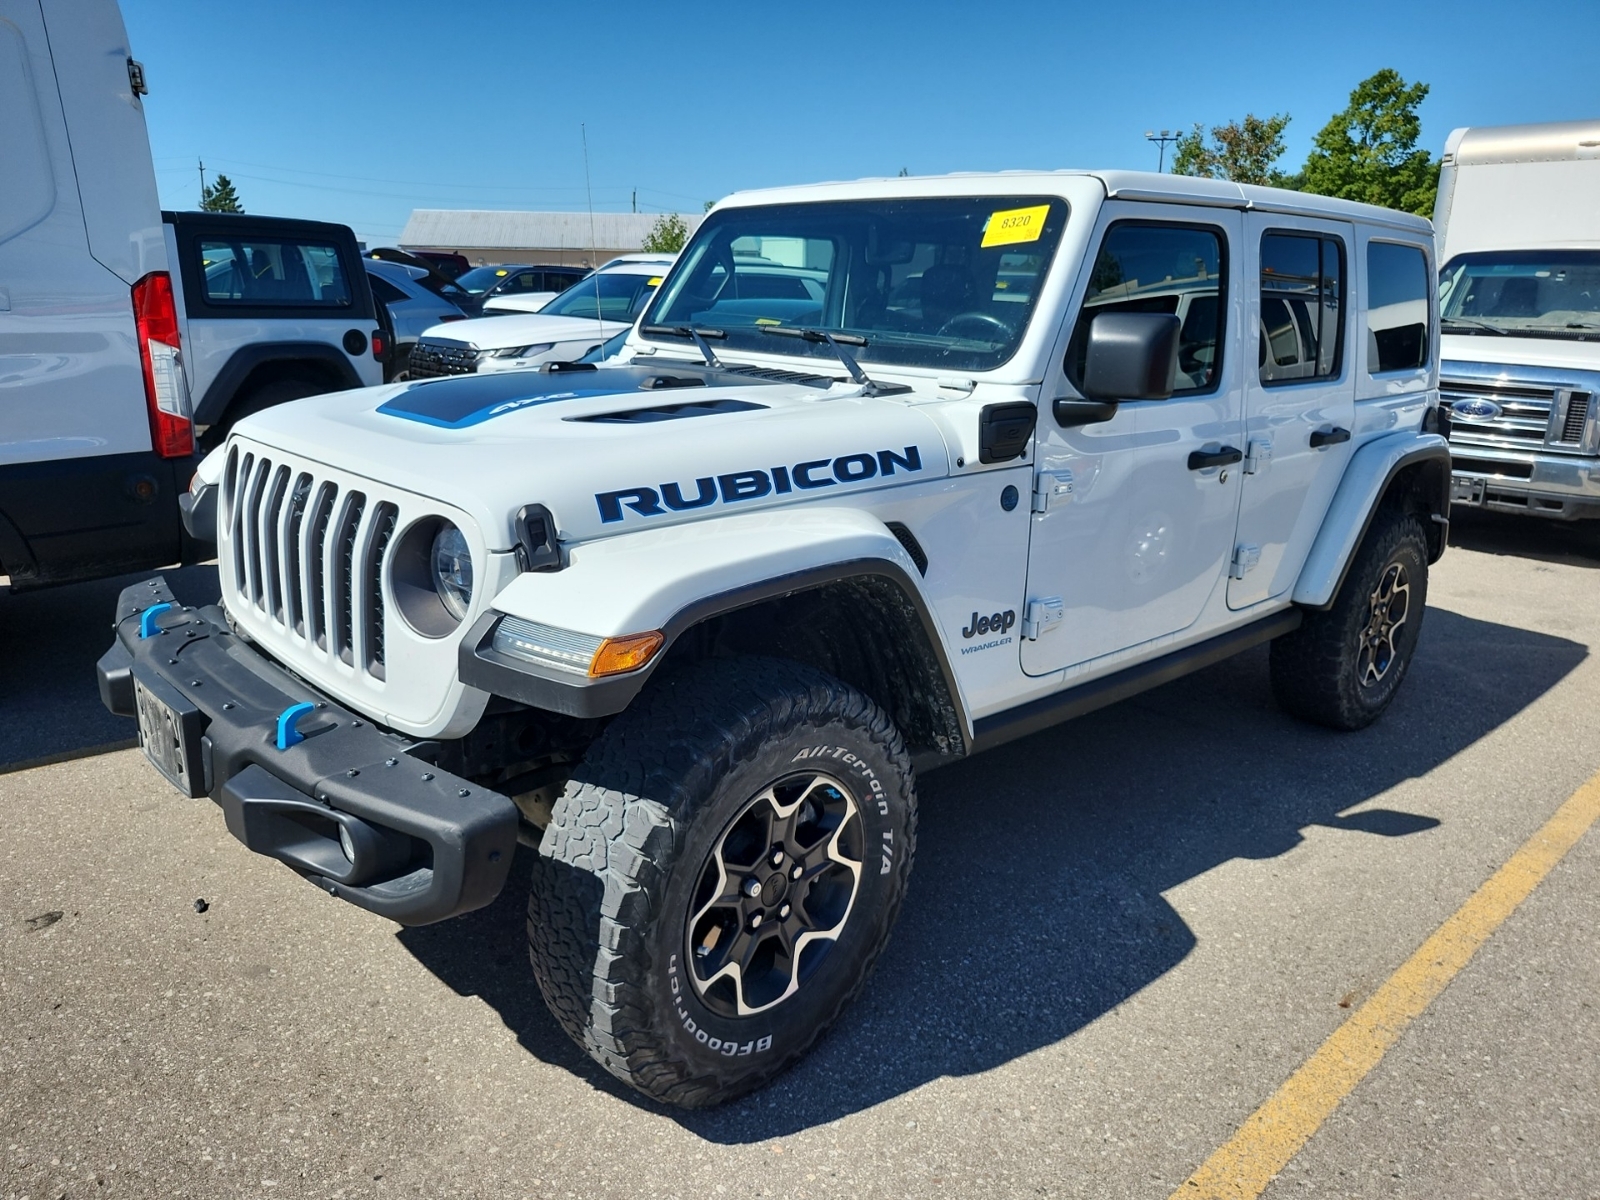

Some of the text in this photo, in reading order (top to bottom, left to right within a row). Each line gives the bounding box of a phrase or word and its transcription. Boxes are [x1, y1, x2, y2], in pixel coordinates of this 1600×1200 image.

[1001, 215, 1031, 229] 8320
[594, 445, 923, 523] RUBICON
[961, 637, 1012, 655] WRANGLER
[962, 609, 1016, 639] Jeep
[791, 745, 895, 875] All-Terrain T/A
[668, 954, 773, 1057] BFGoodrich
